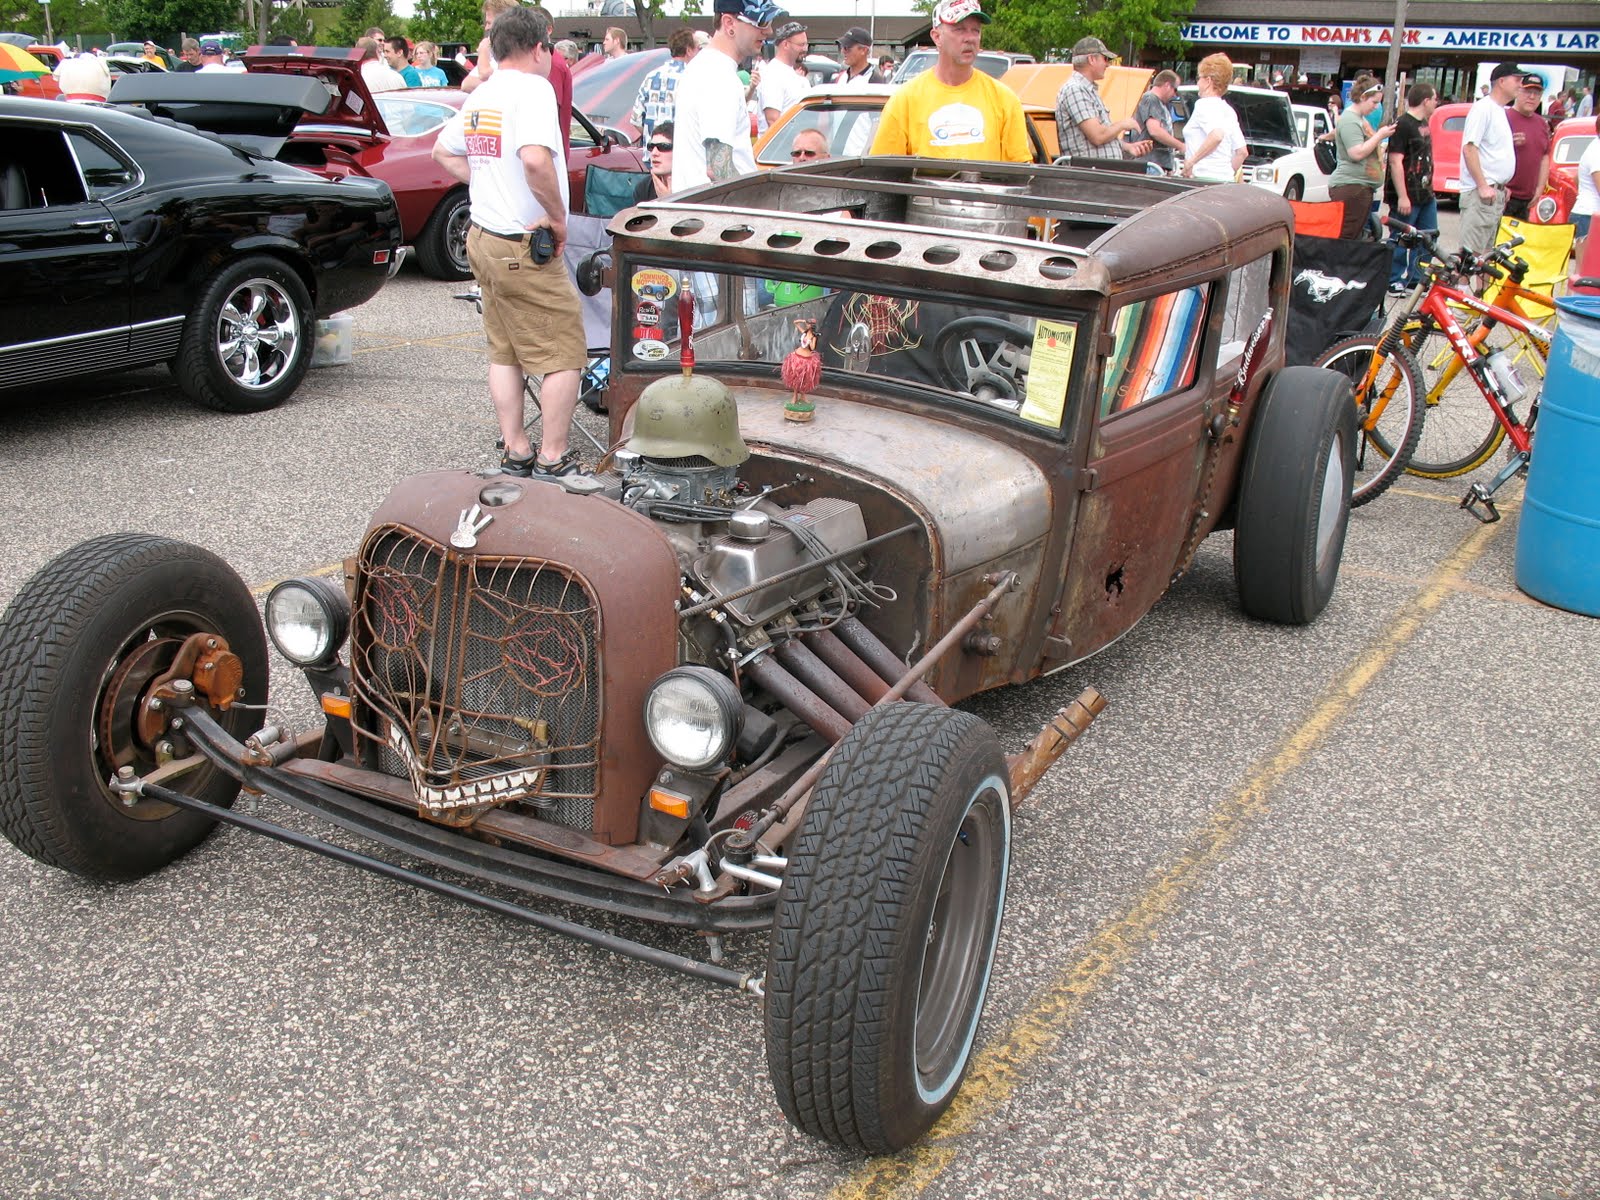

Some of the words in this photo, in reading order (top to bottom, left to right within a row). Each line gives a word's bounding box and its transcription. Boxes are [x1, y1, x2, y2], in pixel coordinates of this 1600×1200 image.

[1267, 27, 1290, 41] TO
[1302, 27, 1372, 44] NOAH'S
[1443, 31, 1548, 47] AMERICA'S
[1234, 319, 1267, 387] Budweiser
